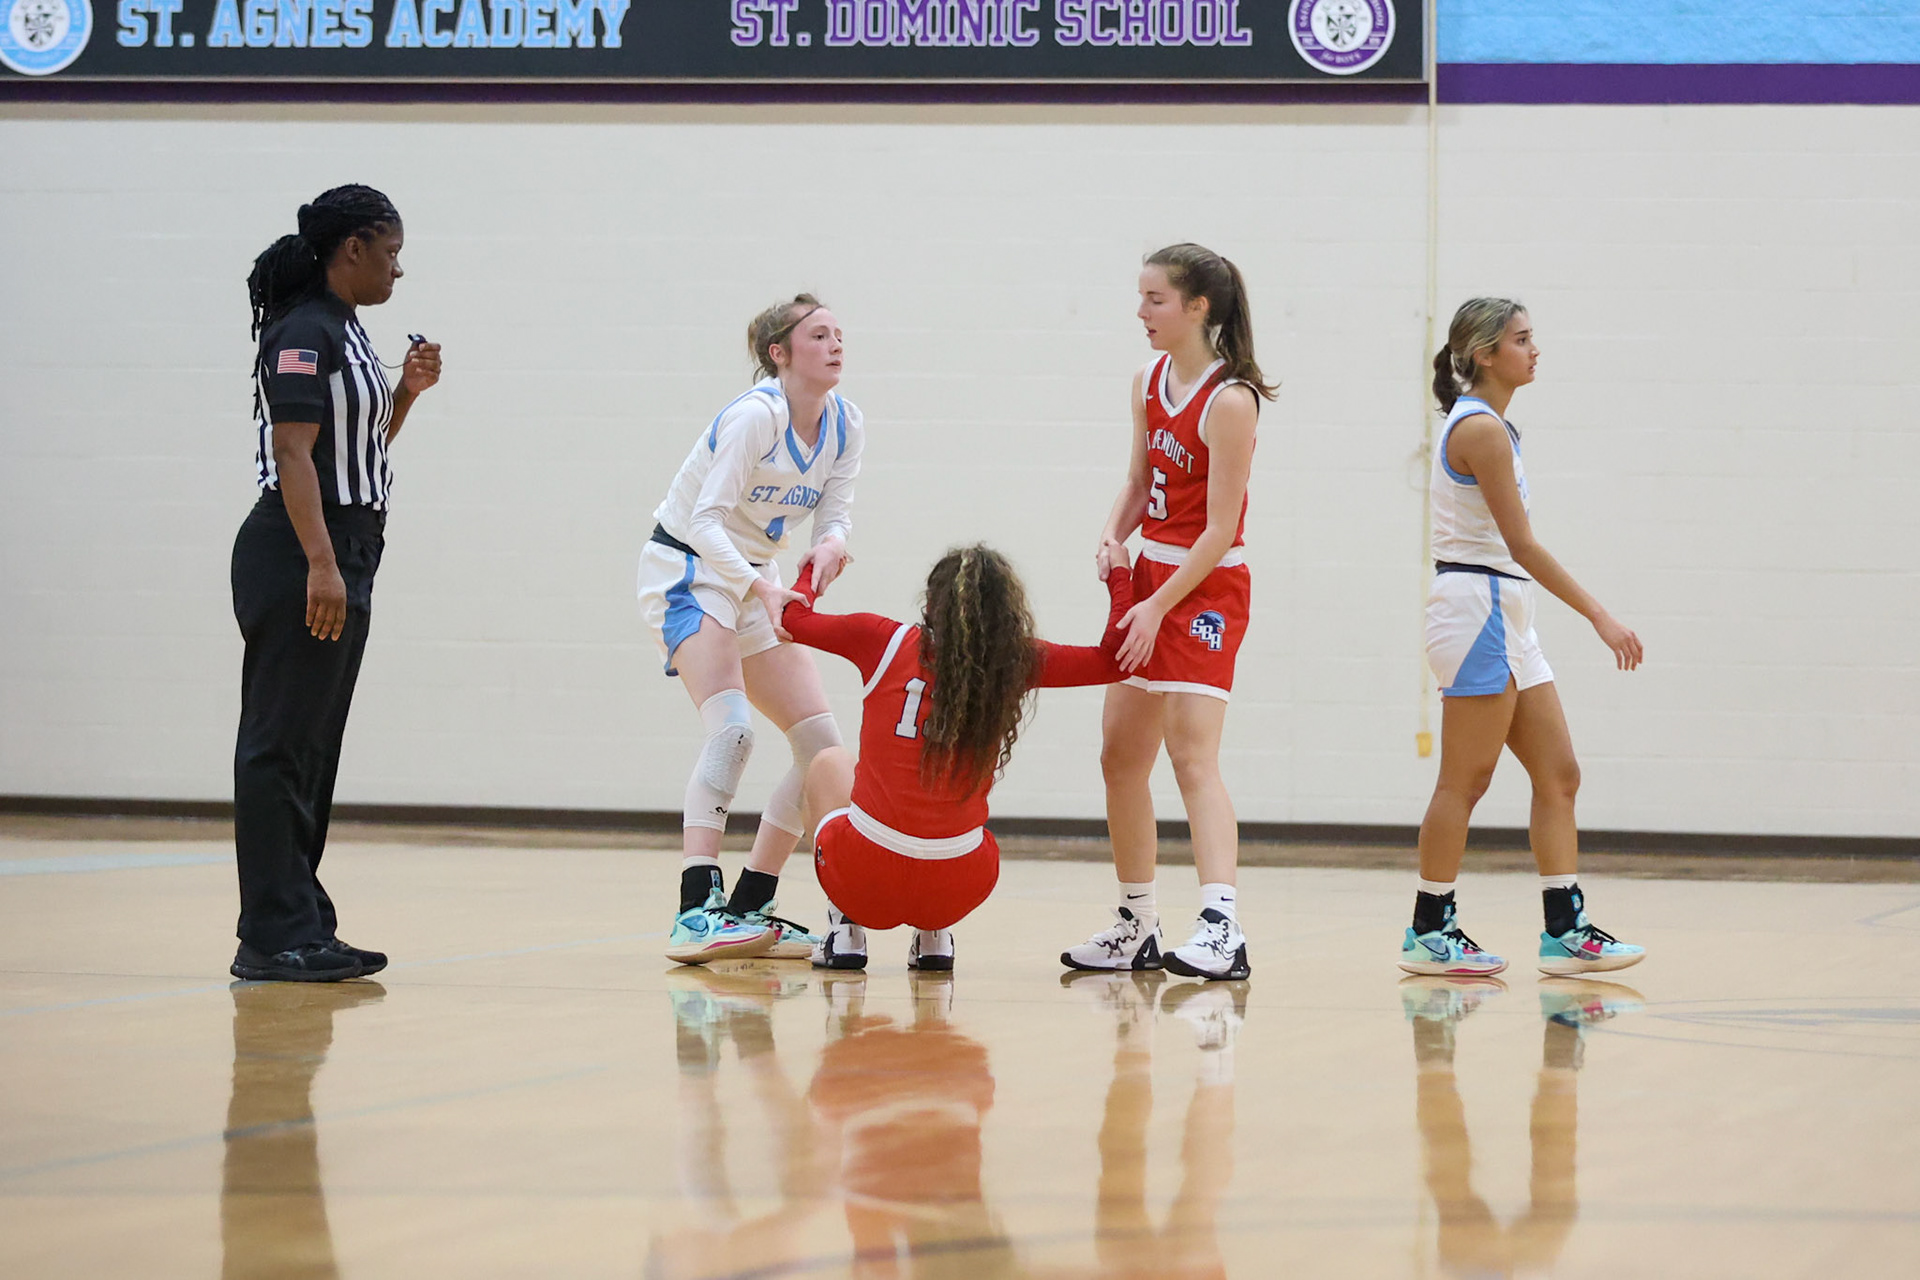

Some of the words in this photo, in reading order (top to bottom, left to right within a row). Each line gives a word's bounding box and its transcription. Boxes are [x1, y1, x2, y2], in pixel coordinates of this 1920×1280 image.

[115, 0, 195, 47] ST.
[206, 0, 374, 47] AGNES
[385, 0, 631, 48] ACADEMY
[731, 0, 811, 46] ST.
[824, 0, 1041, 46] DOMINIC
[1054, 0, 1253, 46] SCHOOL
[748, 485, 781, 503] ST.
[778, 484, 823, 510] AGNE
[1148, 465, 1169, 521] 5
